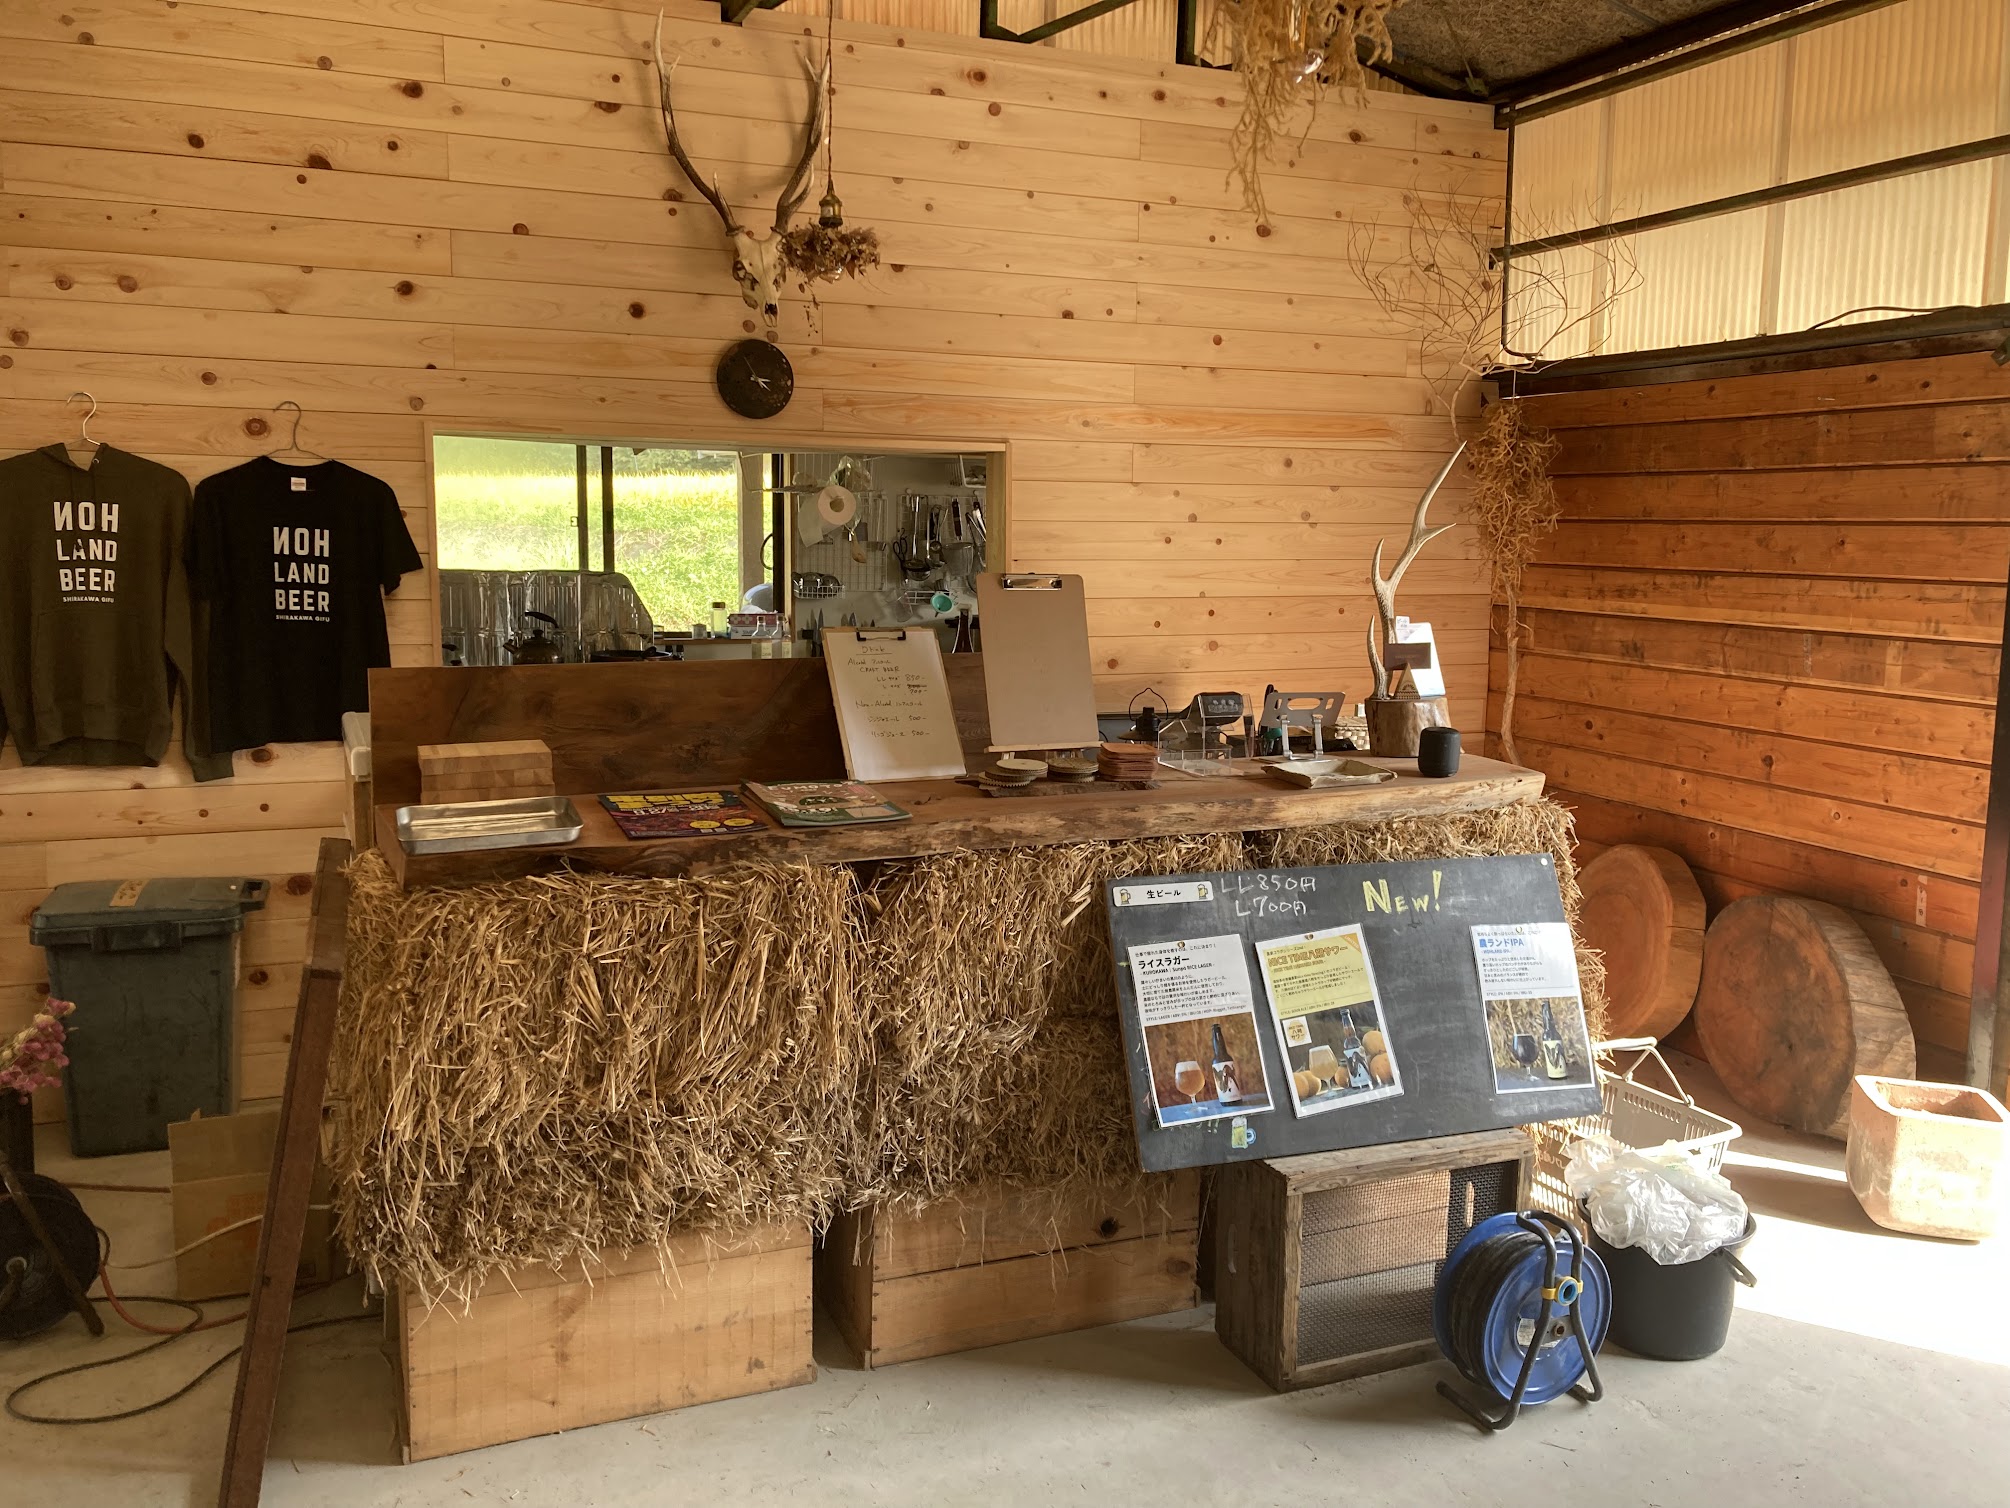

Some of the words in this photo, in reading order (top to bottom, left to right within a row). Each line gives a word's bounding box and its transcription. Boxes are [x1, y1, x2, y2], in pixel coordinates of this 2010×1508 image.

[56, 538, 118, 562] LAND
[59, 567, 116, 592] BEER
[273, 561, 330, 585] LAND
[274, 588, 330, 613] BEER
[1146, 888, 1182, 900] 生ビール
[1137, 955, 1189, 970] ライスラガー
